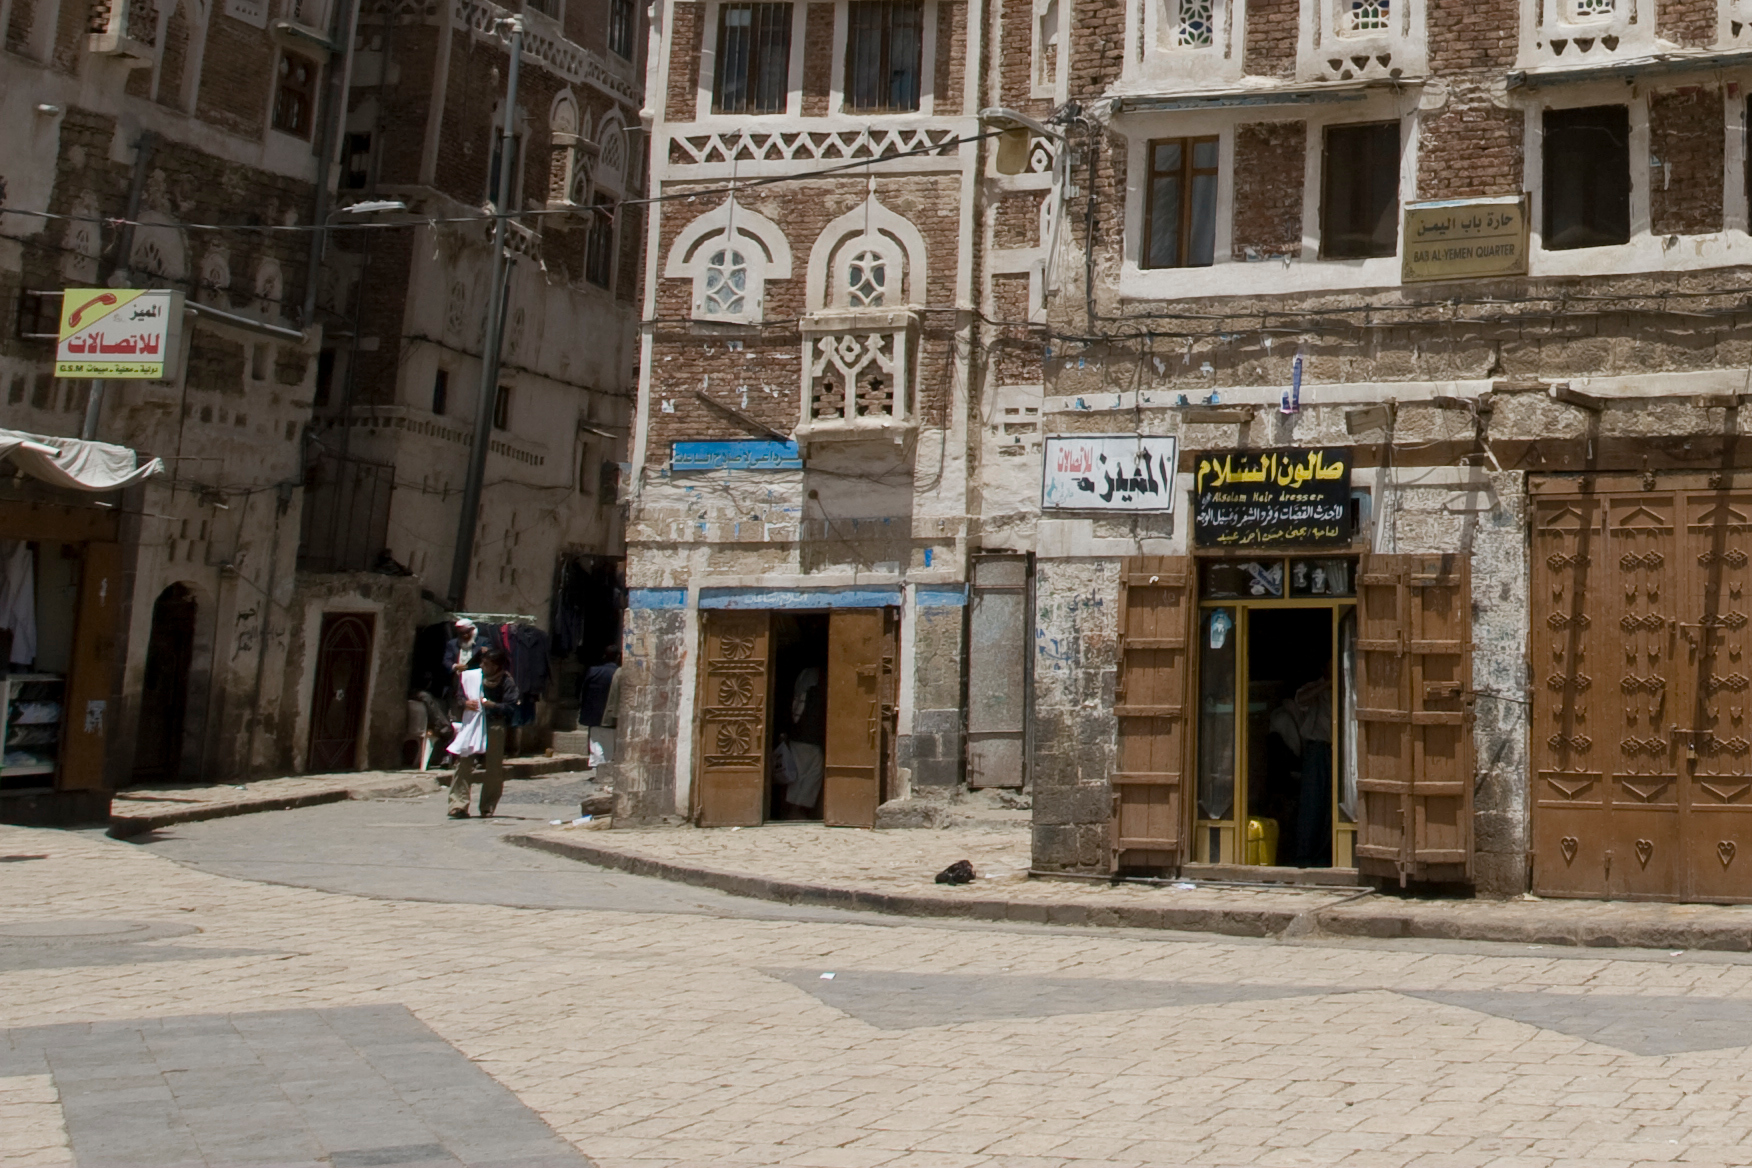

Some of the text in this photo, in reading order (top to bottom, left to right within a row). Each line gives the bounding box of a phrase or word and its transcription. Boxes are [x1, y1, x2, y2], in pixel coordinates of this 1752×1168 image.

[1417, 212, 1514, 237] حارة باب اليمن
[1413, 244, 1515, 263] BAB AL-YEMEN QUARTER
[67, 331, 160, 355] للاتصالات
[1277, 449, 1345, 489] صالون
[1279, 490, 1325, 502] dresser
